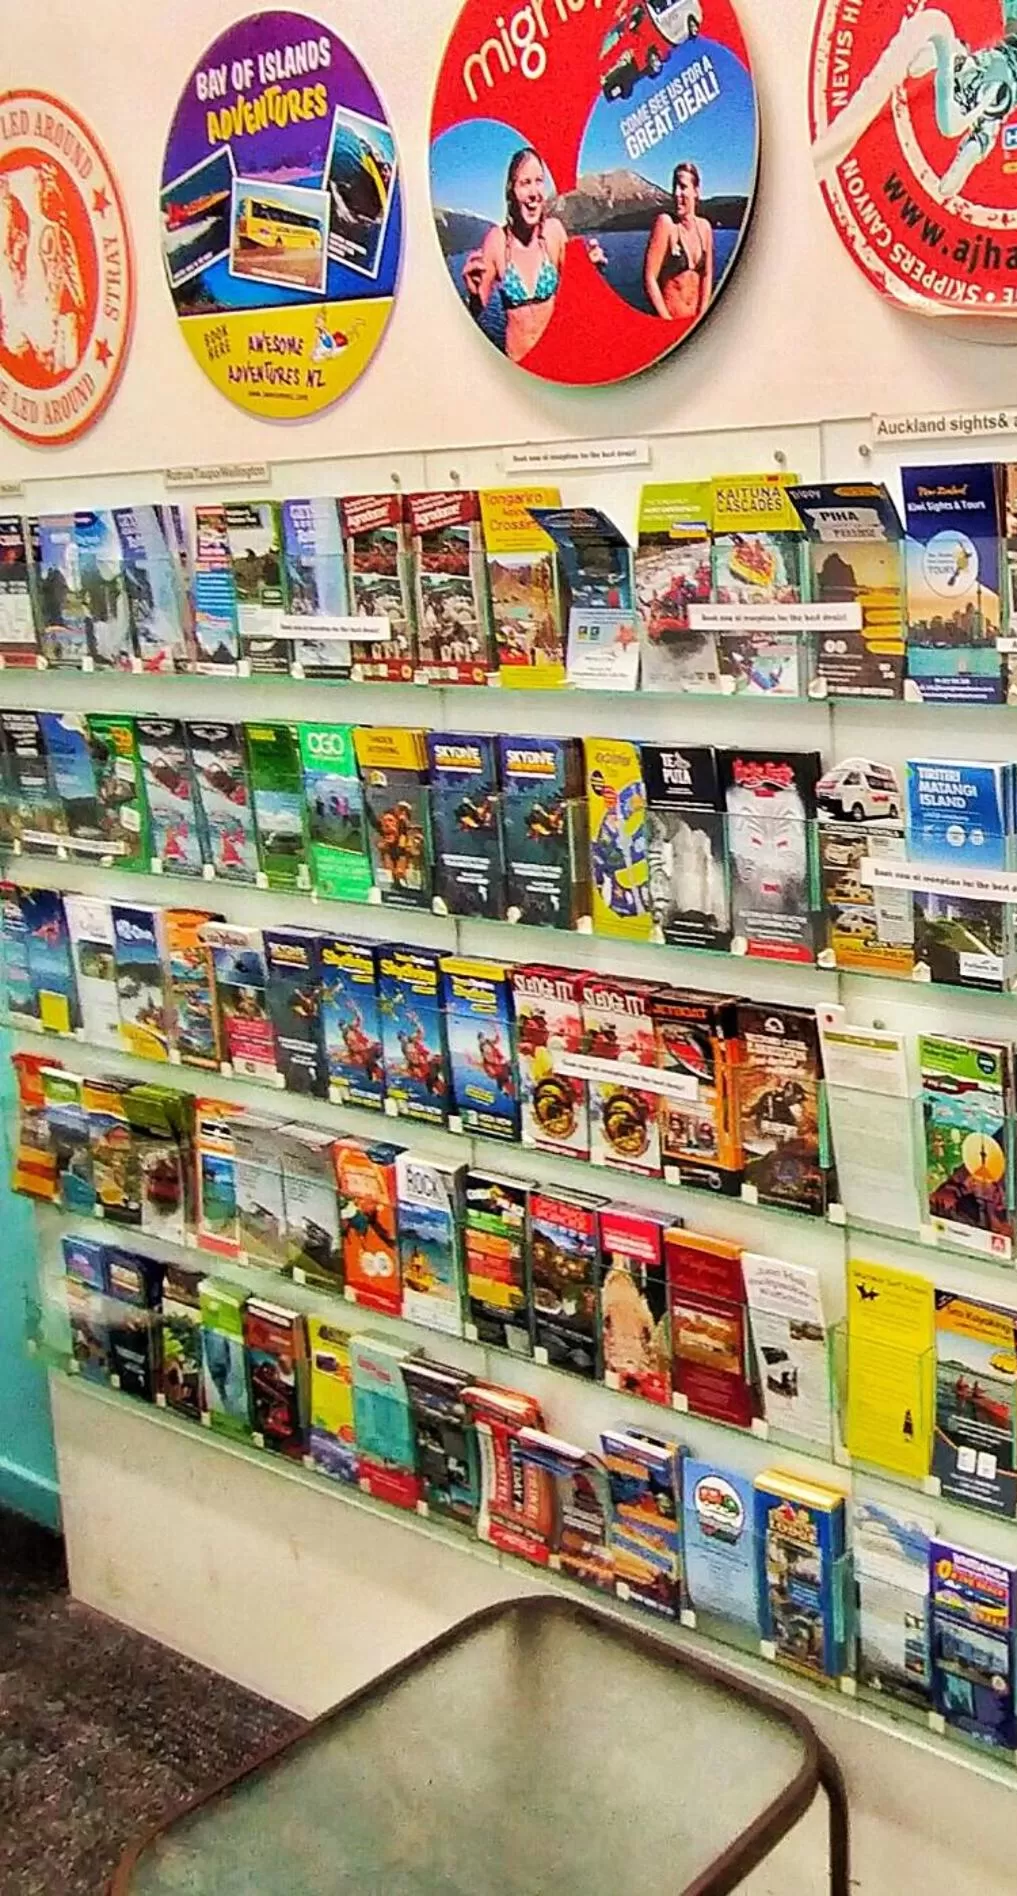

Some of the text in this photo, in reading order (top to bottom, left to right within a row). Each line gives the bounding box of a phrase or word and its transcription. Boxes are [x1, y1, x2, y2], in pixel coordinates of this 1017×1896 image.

[196, 37, 331, 101] BAY OF ISLANDS
[831, 28, 855, 108] NEVIS
[206, 83, 328, 144] ADVENTURES
[619, 103, 651, 139] COME
[650, 89, 670, 116] SEE
[667, 79, 684, 100] US
[681, 64, 704, 92] FOR
[625, 71, 721, 160] GREAT DEAL!
[33, 110, 95, 181] AROUND
[841, 158, 895, 251] CANYON
[102, 236, 121, 322] STRAY
[889, 243, 983, 306] SKIPPERS
[247, 331, 304, 357] AWESOME
[227, 359, 326, 389] ADVENTURES NZ
[44, 372, 96, 426] AROUND
[878, 415, 947, 436] Auckland
[716, 485, 782, 501] KAITUNA
[716, 498, 784, 513] CASCADES
[820, 509, 859, 523] PIHA
[433, 745, 480, 764] SKYDIVE
[506, 749, 555, 766] SKYDIVE
[918, 780, 978, 798] MATANGI
[919, 793, 966, 809] ISLAND
